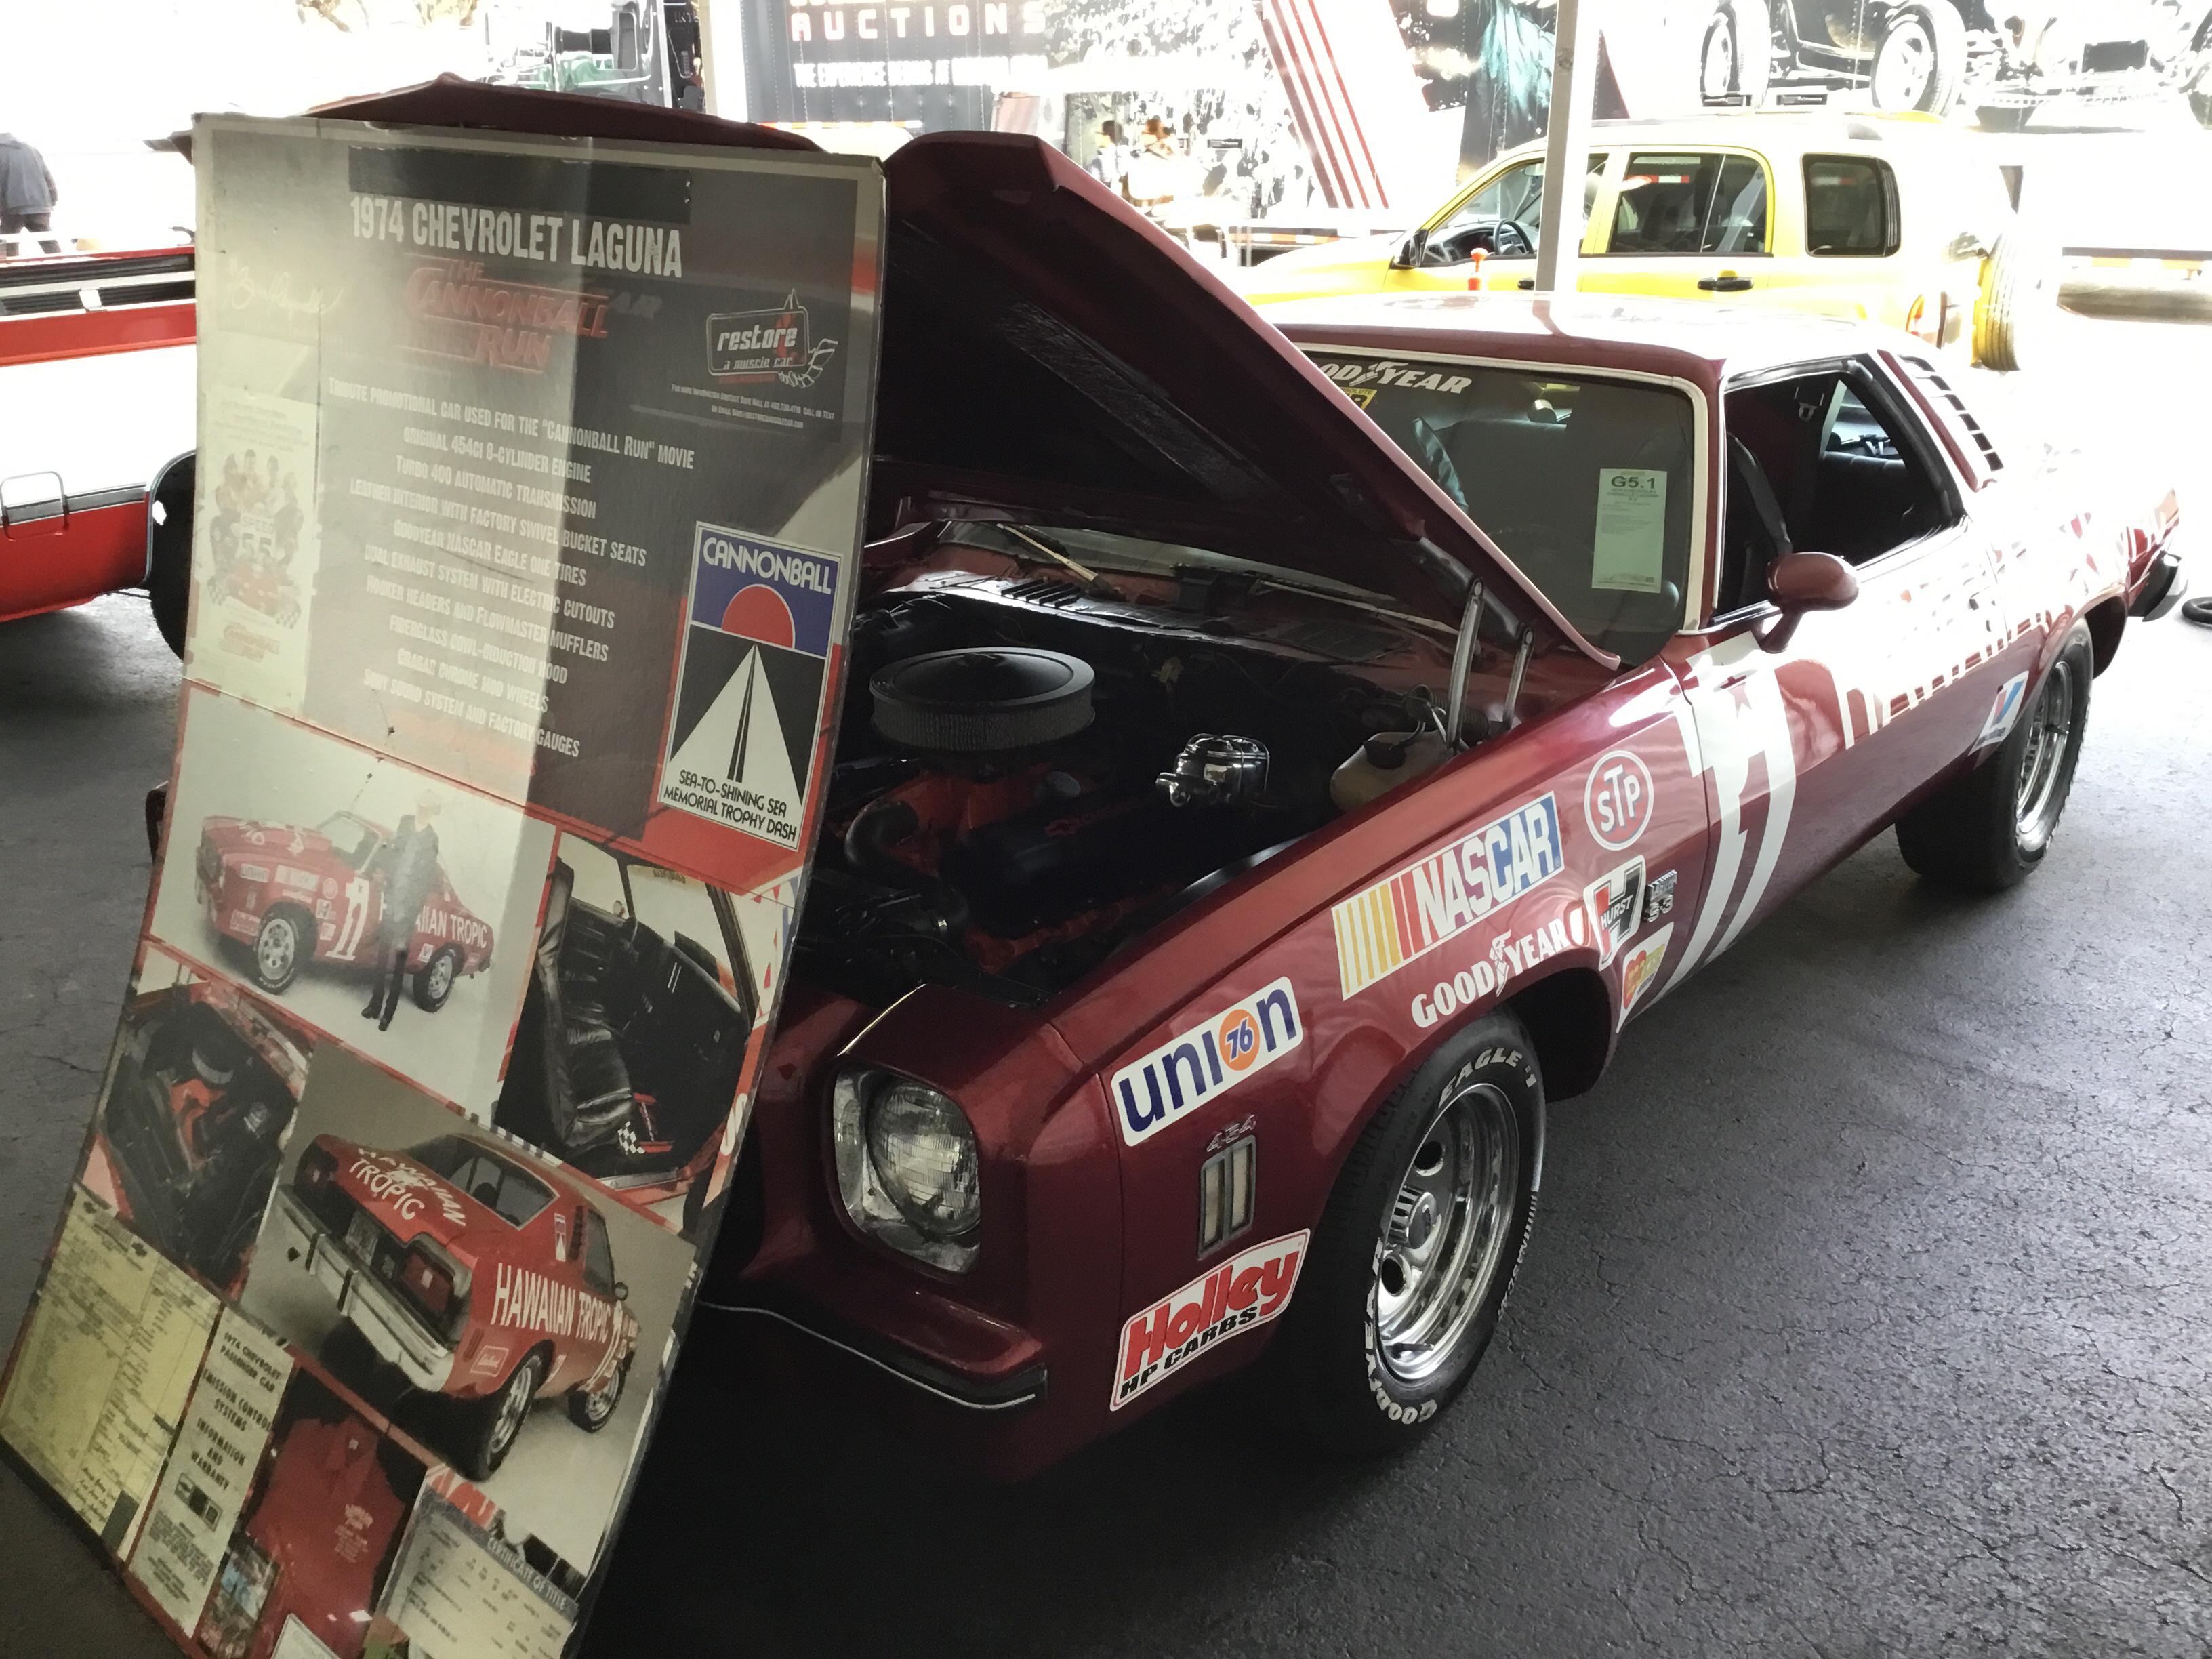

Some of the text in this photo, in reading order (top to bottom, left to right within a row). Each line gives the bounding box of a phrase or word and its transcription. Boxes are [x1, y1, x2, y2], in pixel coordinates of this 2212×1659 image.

[790, 2, 1046, 41] AUCTIONS
[350, 196, 682, 278] 1974 CHEVROLET LAGUNA
[447, 260, 484, 281] THE
[407, 266, 609, 338] CANNONBALL
[475, 327, 552, 367] RUN
[717, 324, 798, 352] restore
[733, 356, 771, 370] muscle
[773, 357, 793, 368] car
[329, 377, 695, 469] TRIBUTE PROMOTIONAL CAR USED FOR THE "CANNONBALL RUN" MOVIE
[404, 426, 592, 483] ORIGINAL 454CI 8-CYLINDER ENGINE
[1611, 476, 1655, 489] G5.1
[396, 455, 596, 519] TURBO 400 AUTOMATIC TRANSMISSION
[350, 476, 647, 567] LEATHER INTERIOR WITH FACTORY SWIVEL BUCKET SEATS
[394, 519, 587, 586] GOODYEAR NASCAR EAGLE ONE TIRES
[703, 537, 832, 595] CANNONBALL
[365, 544, 615, 629] DUAL EXHAUST SYSTEM WITH ELECTRIC CUTOUTS
[367, 574, 609, 662] HOOKER HEADERS AND FLOWMASTER MUFFLERS
[390, 614, 568, 684] FIBERGLASS COWL-INDUCTION HOOD
[397, 647, 549, 713] CRAGAR CHROME MOD WHEELS
[363, 668, 580, 757] SONY SOUND SYSTEM AND FACTORY GAUGES
[664, 787, 798, 842] MEMORIAL TROPHY DASH
[679, 769, 787, 818] SEA-TO-SHINING SEA
[1597, 764, 1641, 832] STP
[1412, 802, 1555, 947] NASCAR
[450, 914, 487, 949] TROPIC
[1601, 893, 1634, 932] HURST
[1226, 1017, 1254, 1063] 76
[1439, 1047, 1523, 1107] EAGLE
[1206, 1114, 1257, 1152] 454
[349, 1158, 426, 1221] TROPIC
[491, 1263, 611, 1343] HAWAIIAN TROPIC
[1123, 1250, 1300, 1381] Holley
[220, 1345, 275, 1393] PASSENGER CAR
[224, 1332, 281, 1380] 1974 CHEVROLET
[1120, 1306, 1258, 1399] HP CARBS
[197, 1417, 245, 1467] INFORMATION
[214, 1398, 247, 1432] SYSTEMS
[192, 1450, 230, 1490] WARRANTY
[207, 1447, 224, 1465] AND
[487, 1536, 566, 1611] CERTIFICATE OF TITLE
